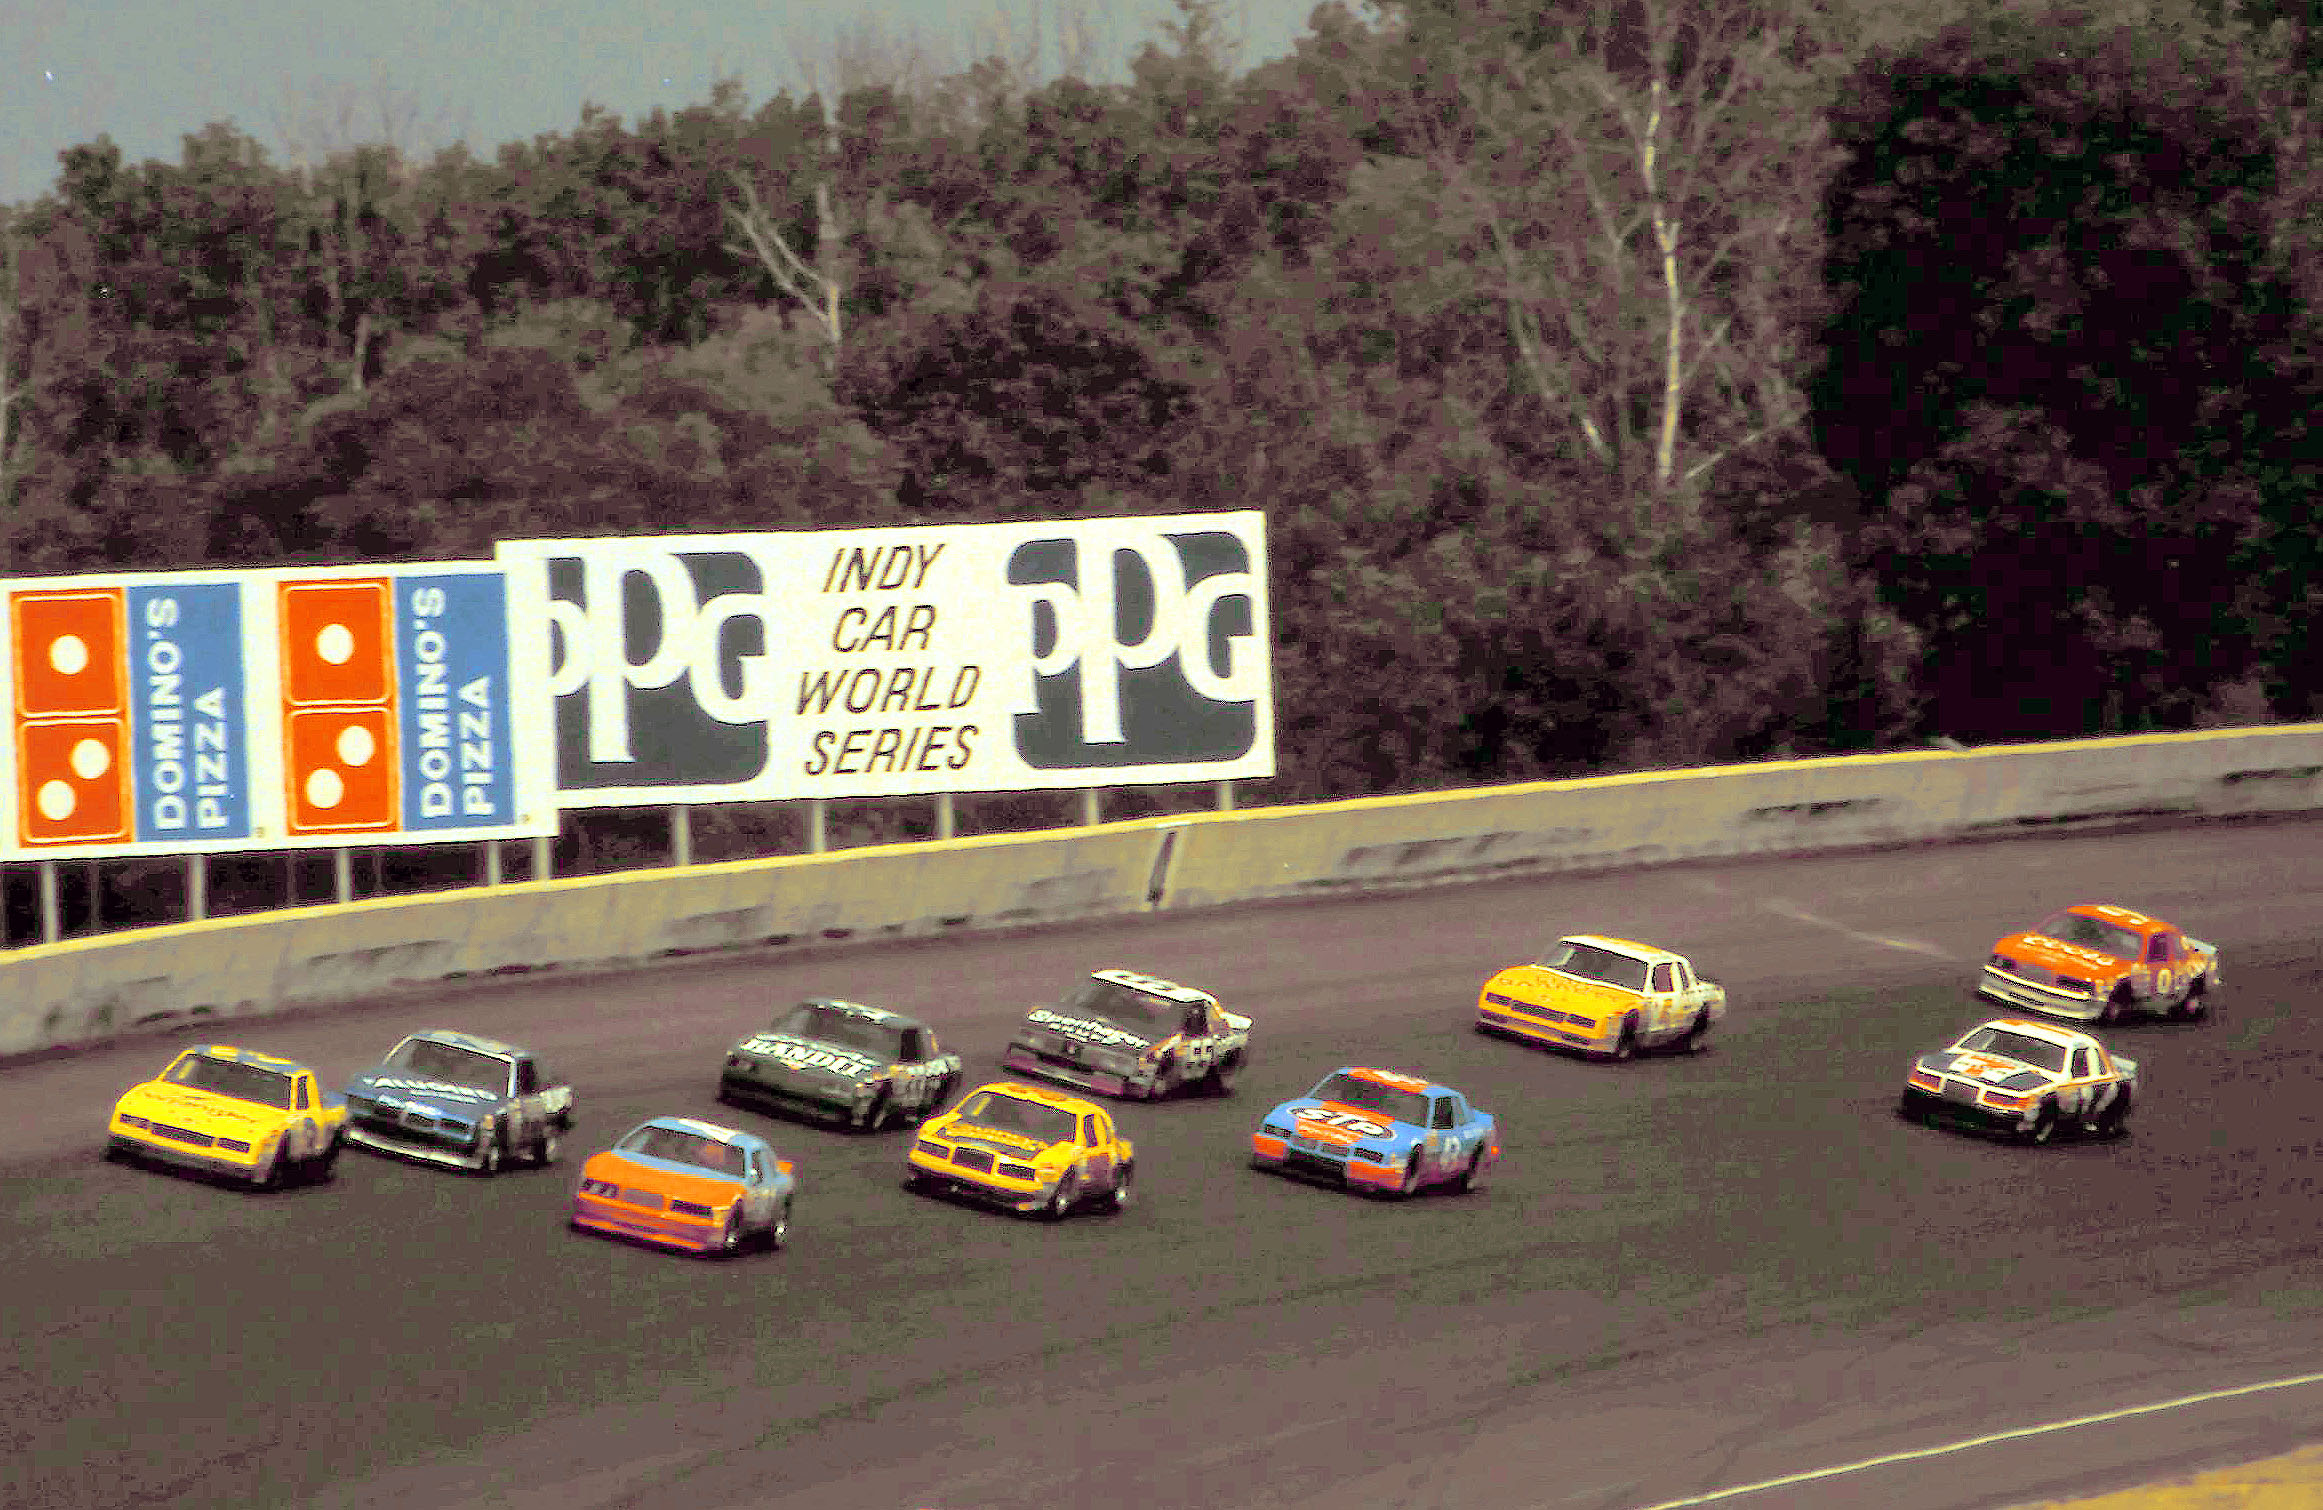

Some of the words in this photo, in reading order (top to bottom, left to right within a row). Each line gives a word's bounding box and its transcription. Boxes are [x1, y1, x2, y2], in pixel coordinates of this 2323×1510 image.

[821, 543, 945, 592] INDY
[832, 604, 937, 653] CAR
[145, 597, 187, 831] DOMINO'S
[411, 586, 452, 819] DOMINO'S
[796, 665, 981, 715] WORLD
[194, 686, 229, 830] PIZZA
[457, 675, 494, 816] PIZZA
[804, 725, 979, 776] SERIES
[1294, 1106, 1388, 1140] STP
